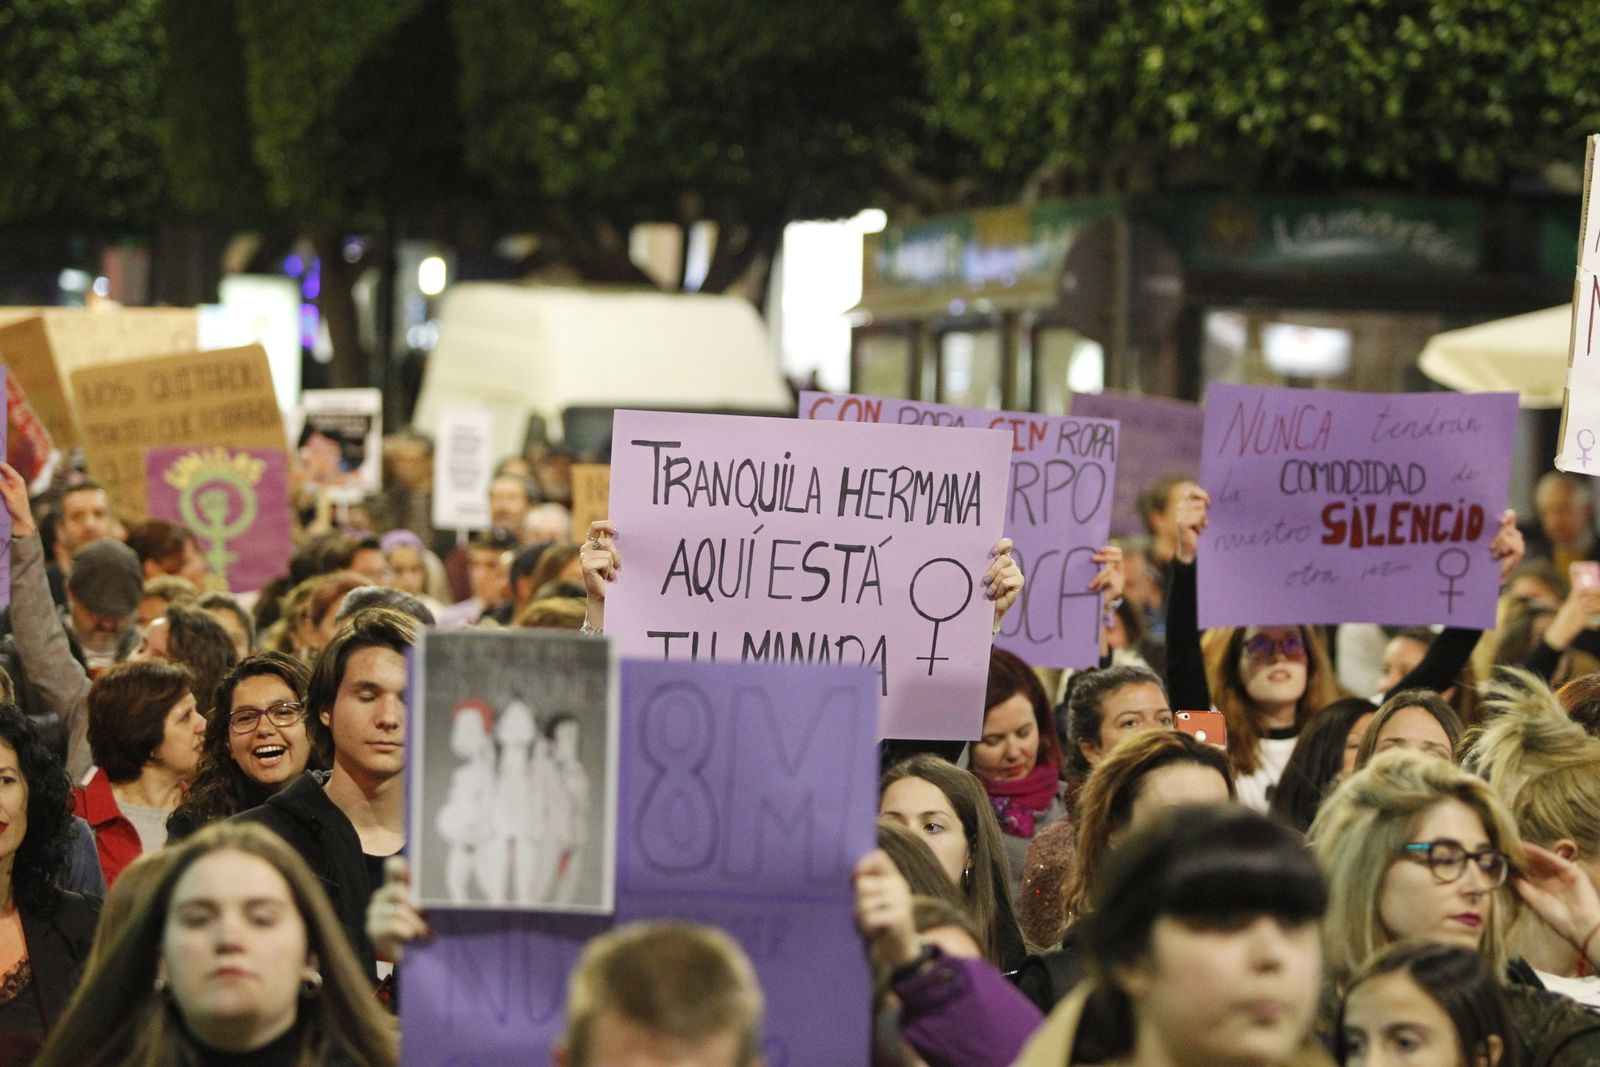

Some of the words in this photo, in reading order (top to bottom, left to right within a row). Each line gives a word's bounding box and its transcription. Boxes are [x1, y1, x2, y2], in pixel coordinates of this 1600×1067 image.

[1057, 420, 1116, 462] ROPA
[1217, 393, 1334, 457] NUNCA
[837, 465, 982, 527] HERMANA
[1010, 460, 1106, 526] RPO
[1279, 458, 1427, 496] COMODIDAD
[660, 524, 766, 603] AQUÍ
[767, 535, 893, 607] ESTÁ
[1000, 546, 1101, 646] OCA
[634, 678, 860, 887] 8M
